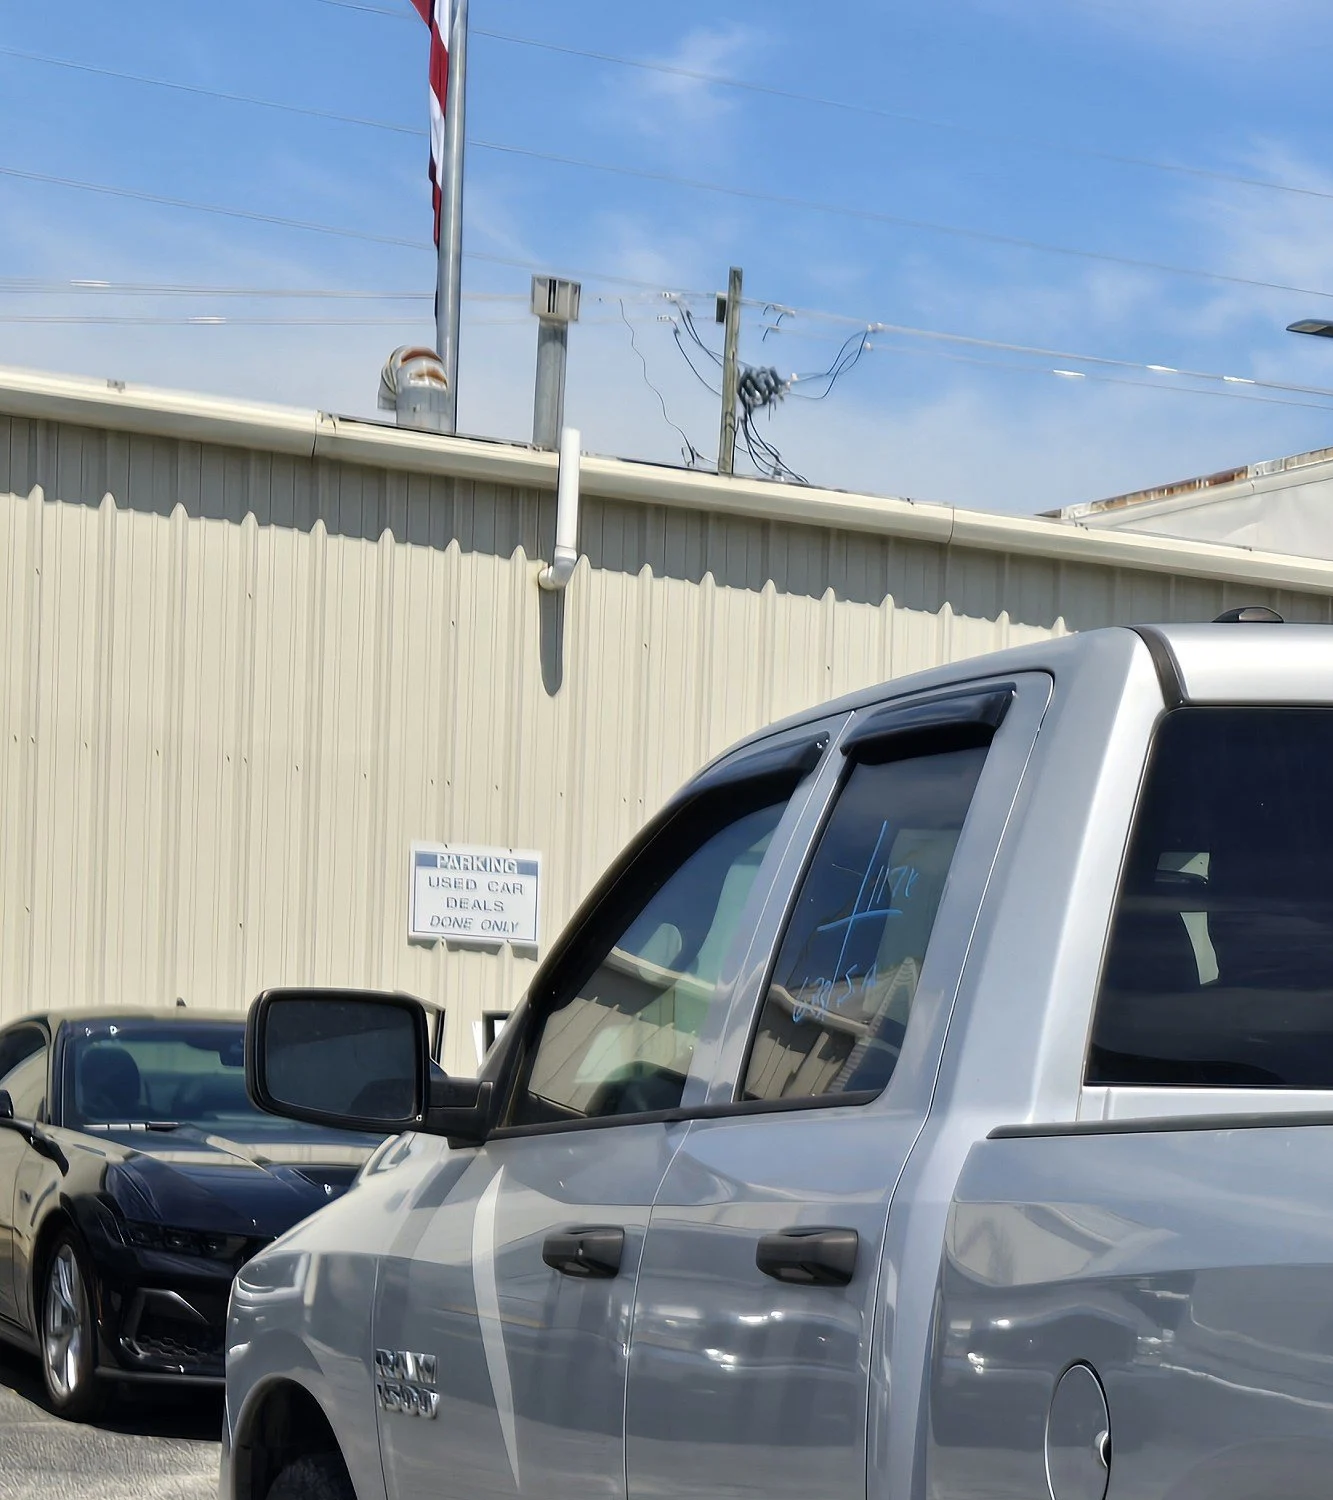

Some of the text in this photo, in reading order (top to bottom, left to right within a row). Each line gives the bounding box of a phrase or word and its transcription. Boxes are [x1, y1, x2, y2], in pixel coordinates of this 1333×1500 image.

[437, 854, 518, 873] PARKING
[428, 876, 523, 895] USED CAR
[446, 897, 504, 911] DEALS
[430, 915, 519, 933] DONE ONLY
[375, 1348, 436, 1383] RAM
[376, 1383, 439, 1417] 1500
